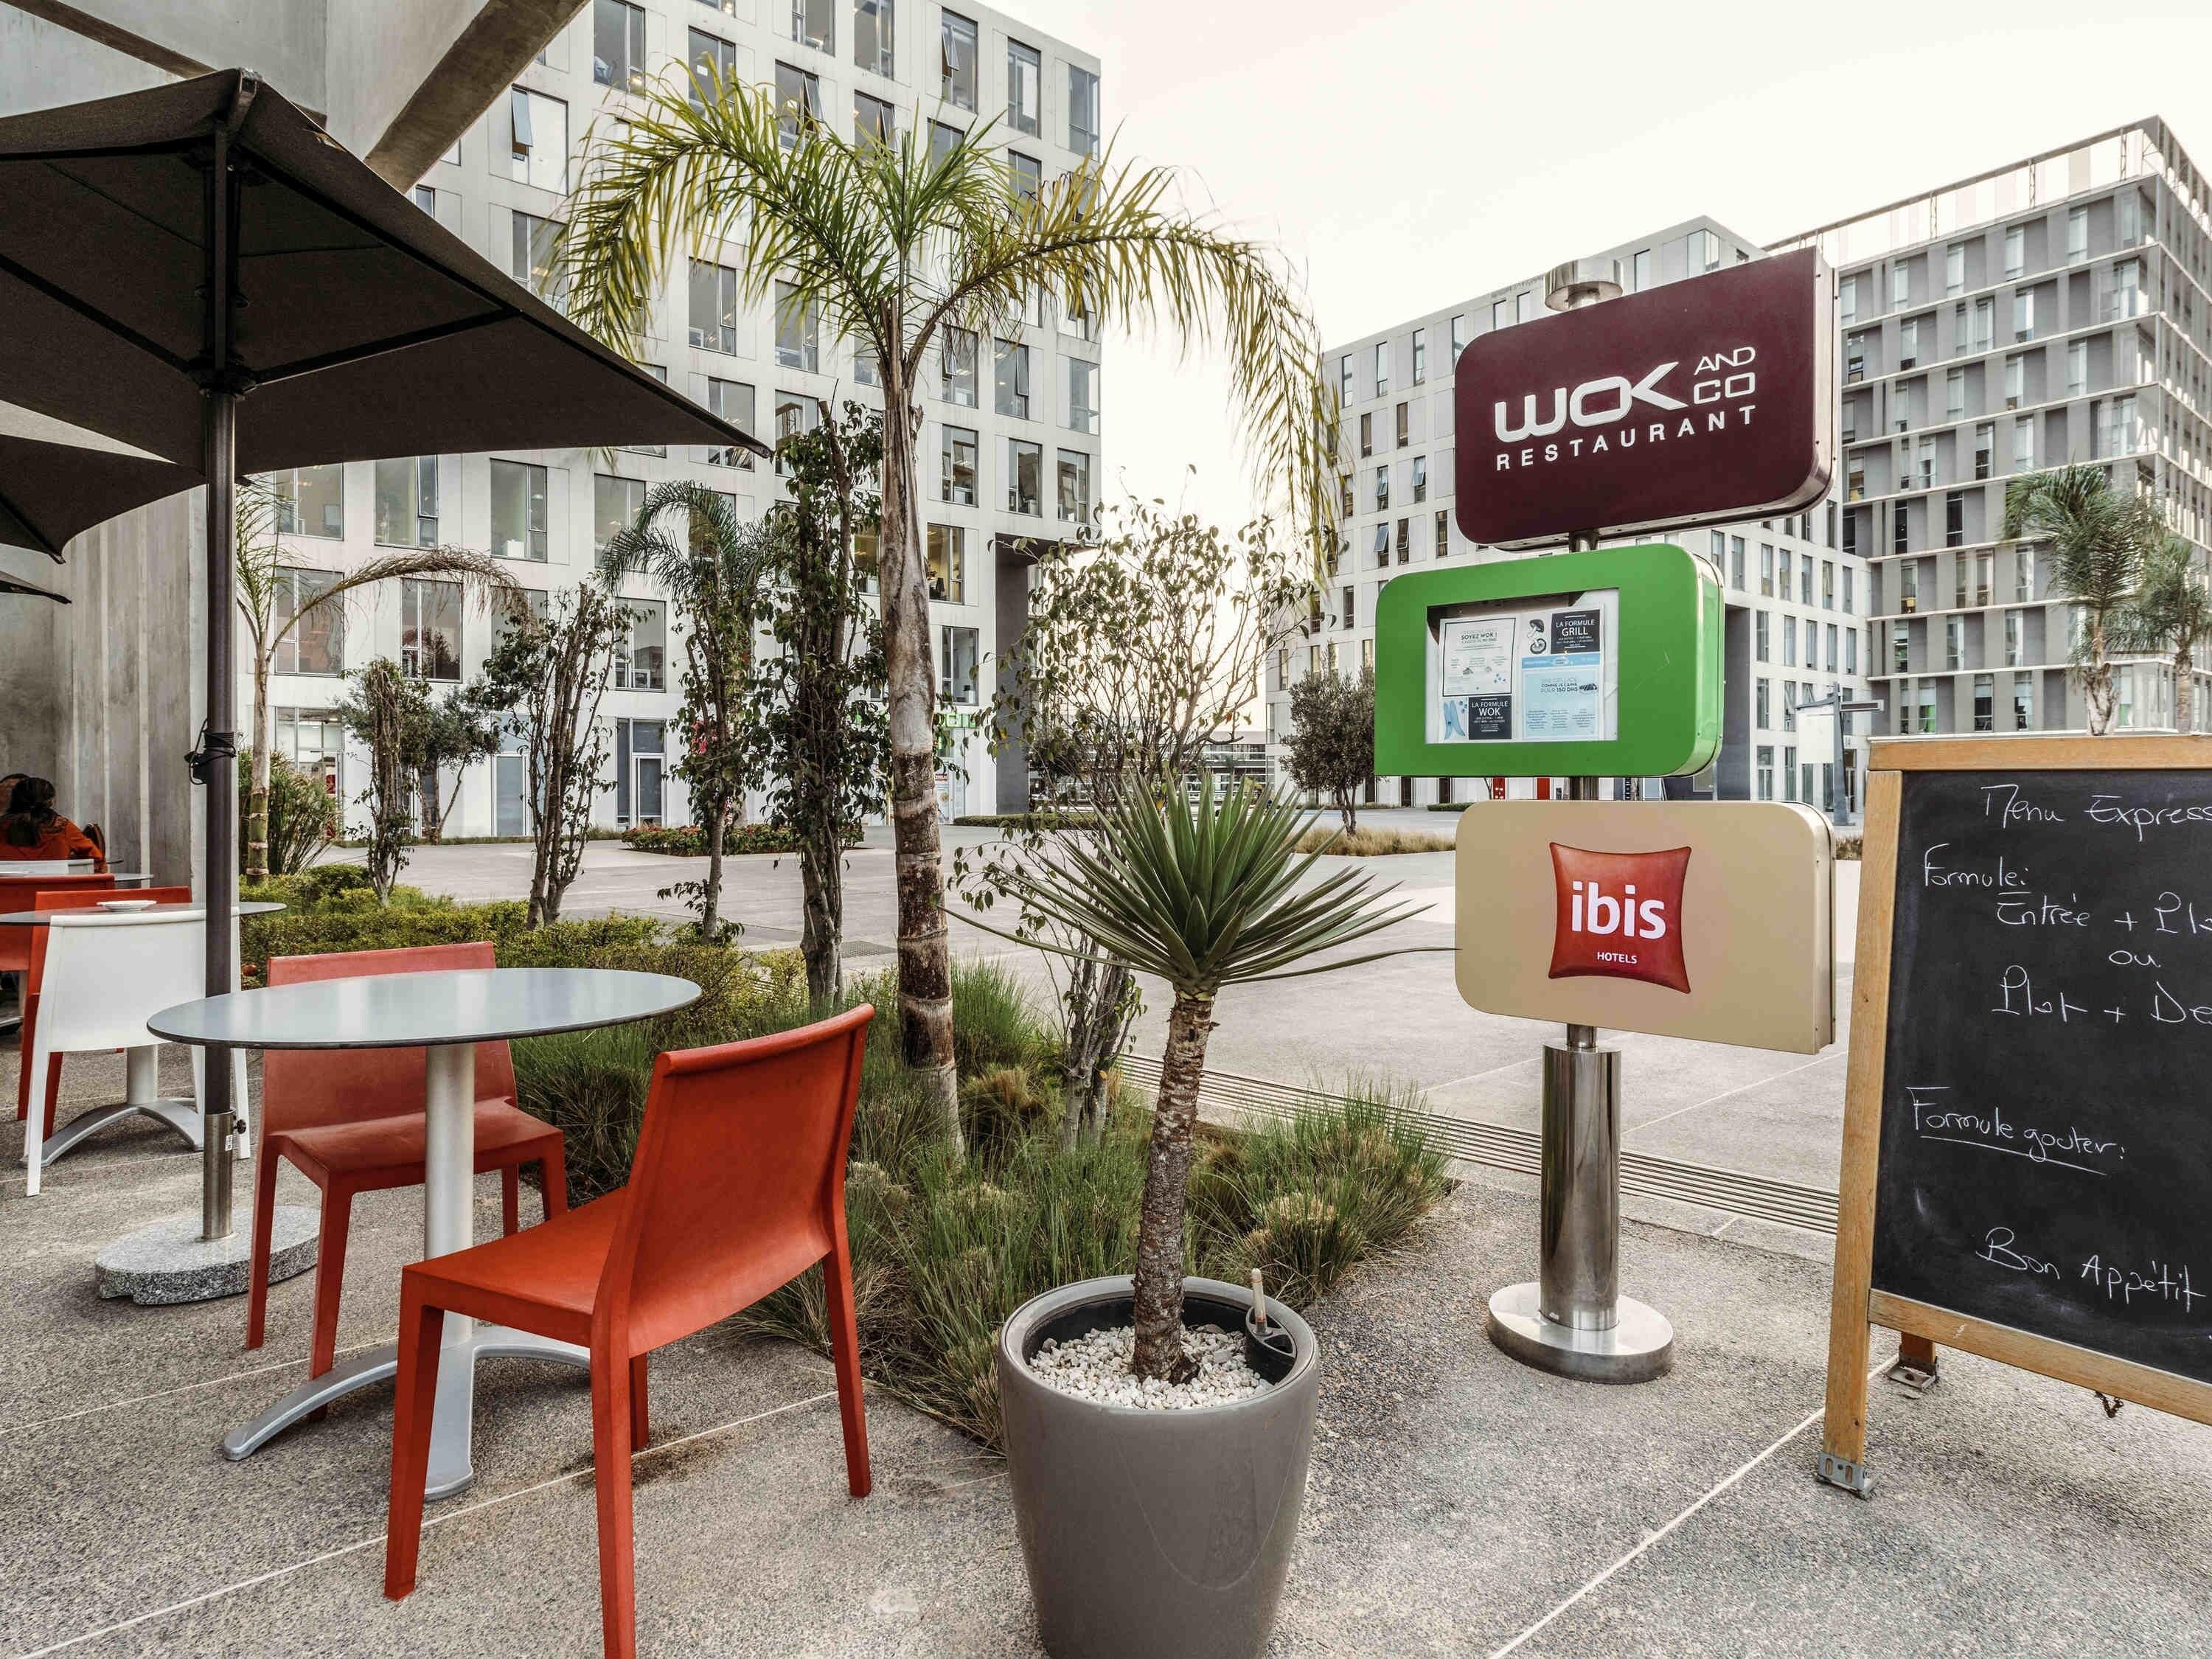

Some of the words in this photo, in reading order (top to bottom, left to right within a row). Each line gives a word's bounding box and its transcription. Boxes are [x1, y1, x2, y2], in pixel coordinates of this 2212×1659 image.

[1694, 347, 1756, 375] AND
[1495, 361, 1689, 443] WOK
[1694, 372, 1756, 405] CO
[1496, 405, 1756, 471] RESTAURANT
[1562, 627, 1587, 636] GRILL
[1478, 707, 1501, 716] WOK
[1980, 783, 2065, 829] Menu
[1571, 880, 1666, 939] ibis
[1596, 951, 1638, 964] HOTELS
[1905, 1086, 2014, 1138] Formule
[1975, 1227, 2060, 1280] Bon
